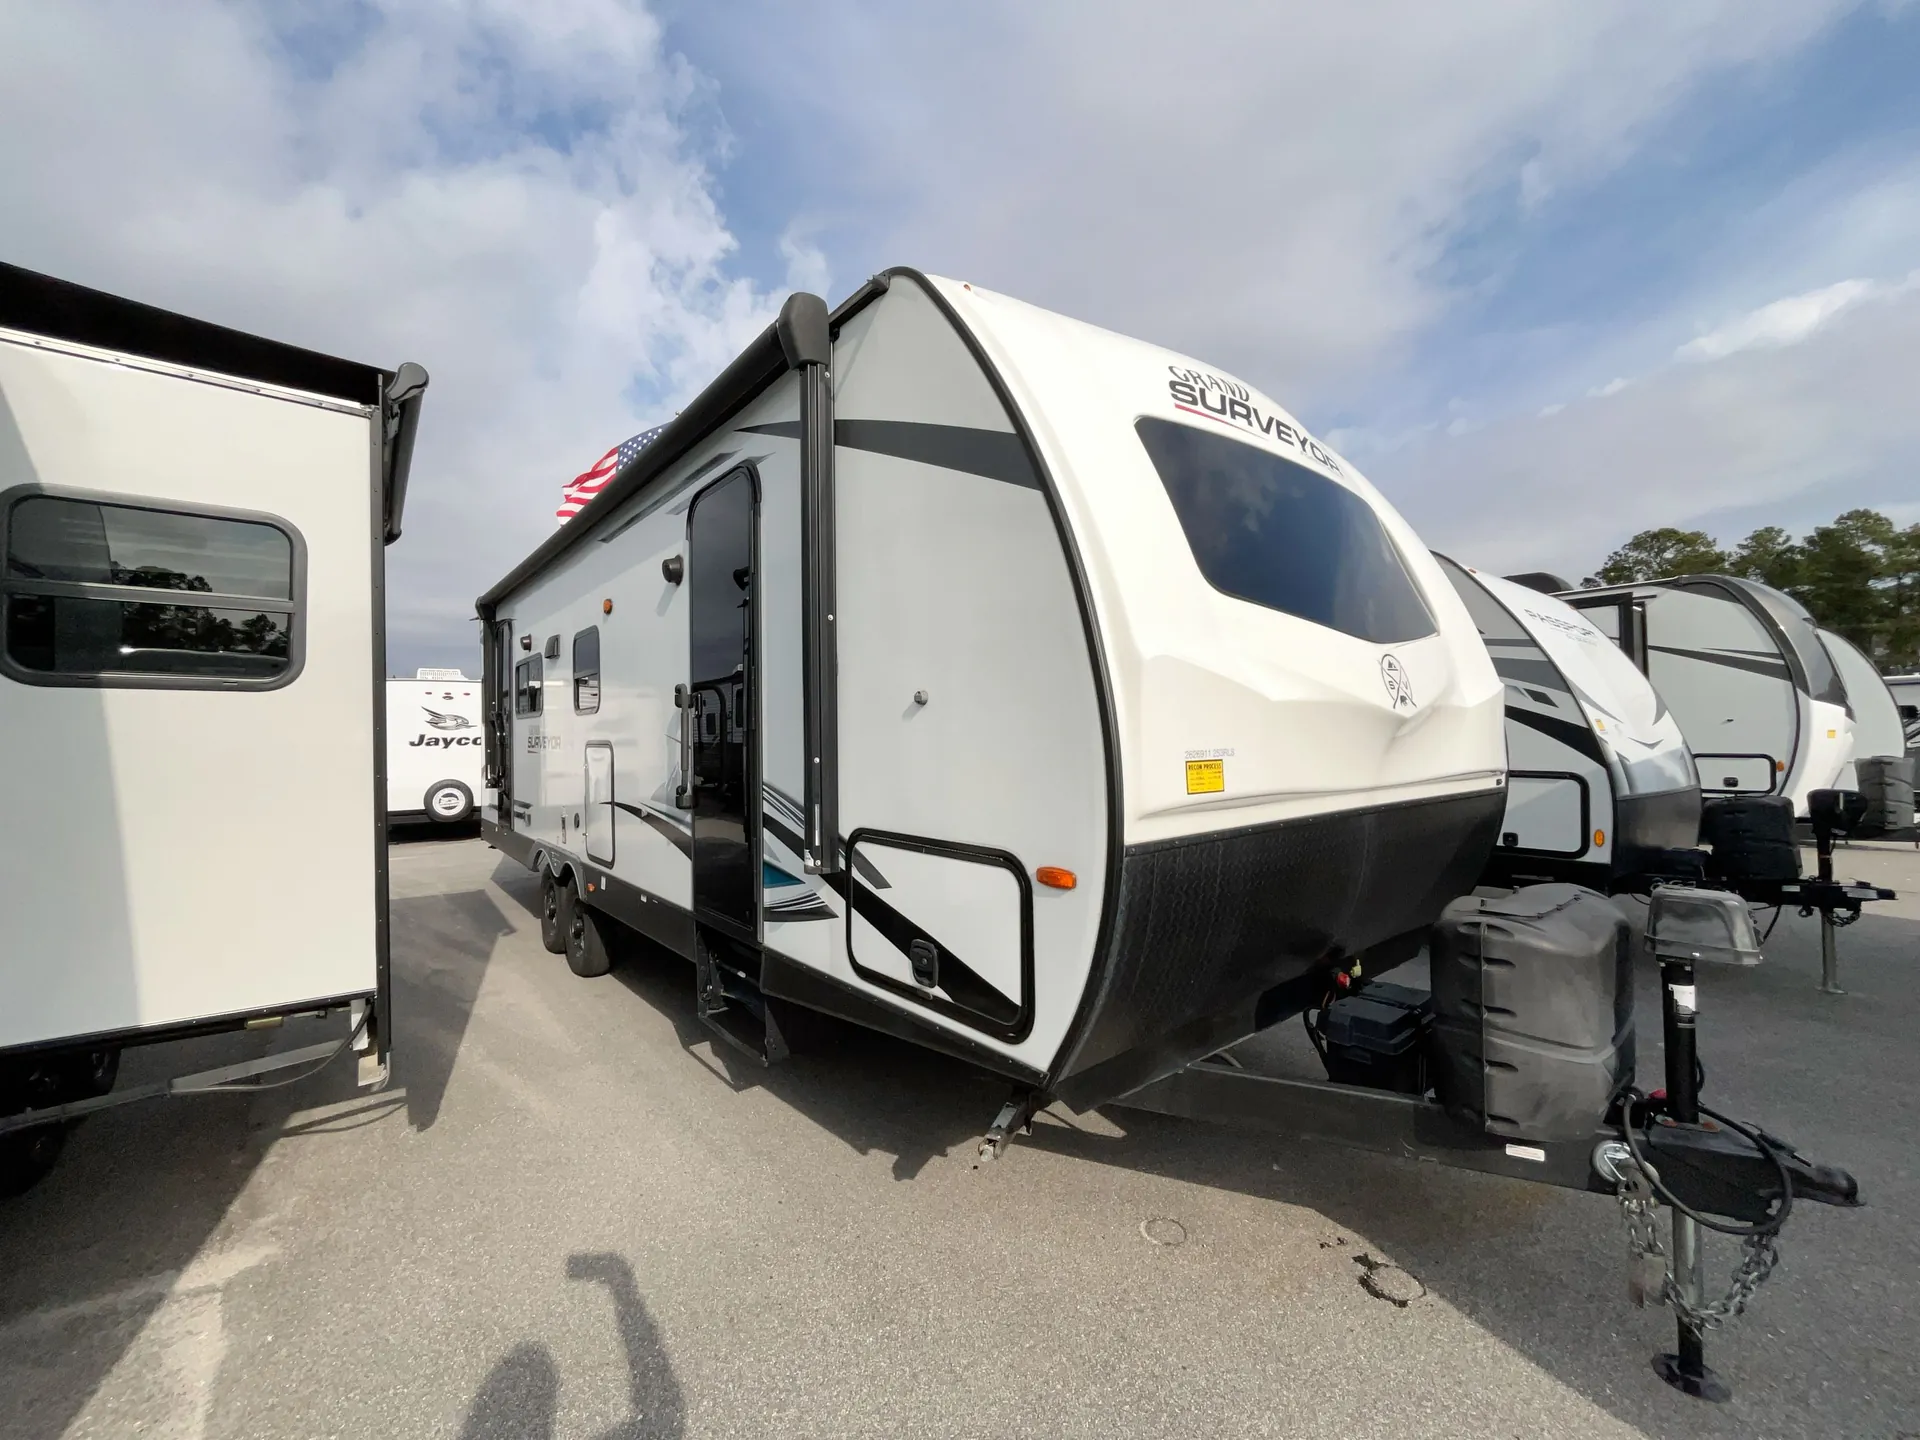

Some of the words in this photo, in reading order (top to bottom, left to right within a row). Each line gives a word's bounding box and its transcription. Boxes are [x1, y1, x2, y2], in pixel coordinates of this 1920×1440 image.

[1168, 365, 1250, 402] GRAND
[1168, 380, 1344, 477] SURVEYOR
[409, 733, 482, 749] Jayco
